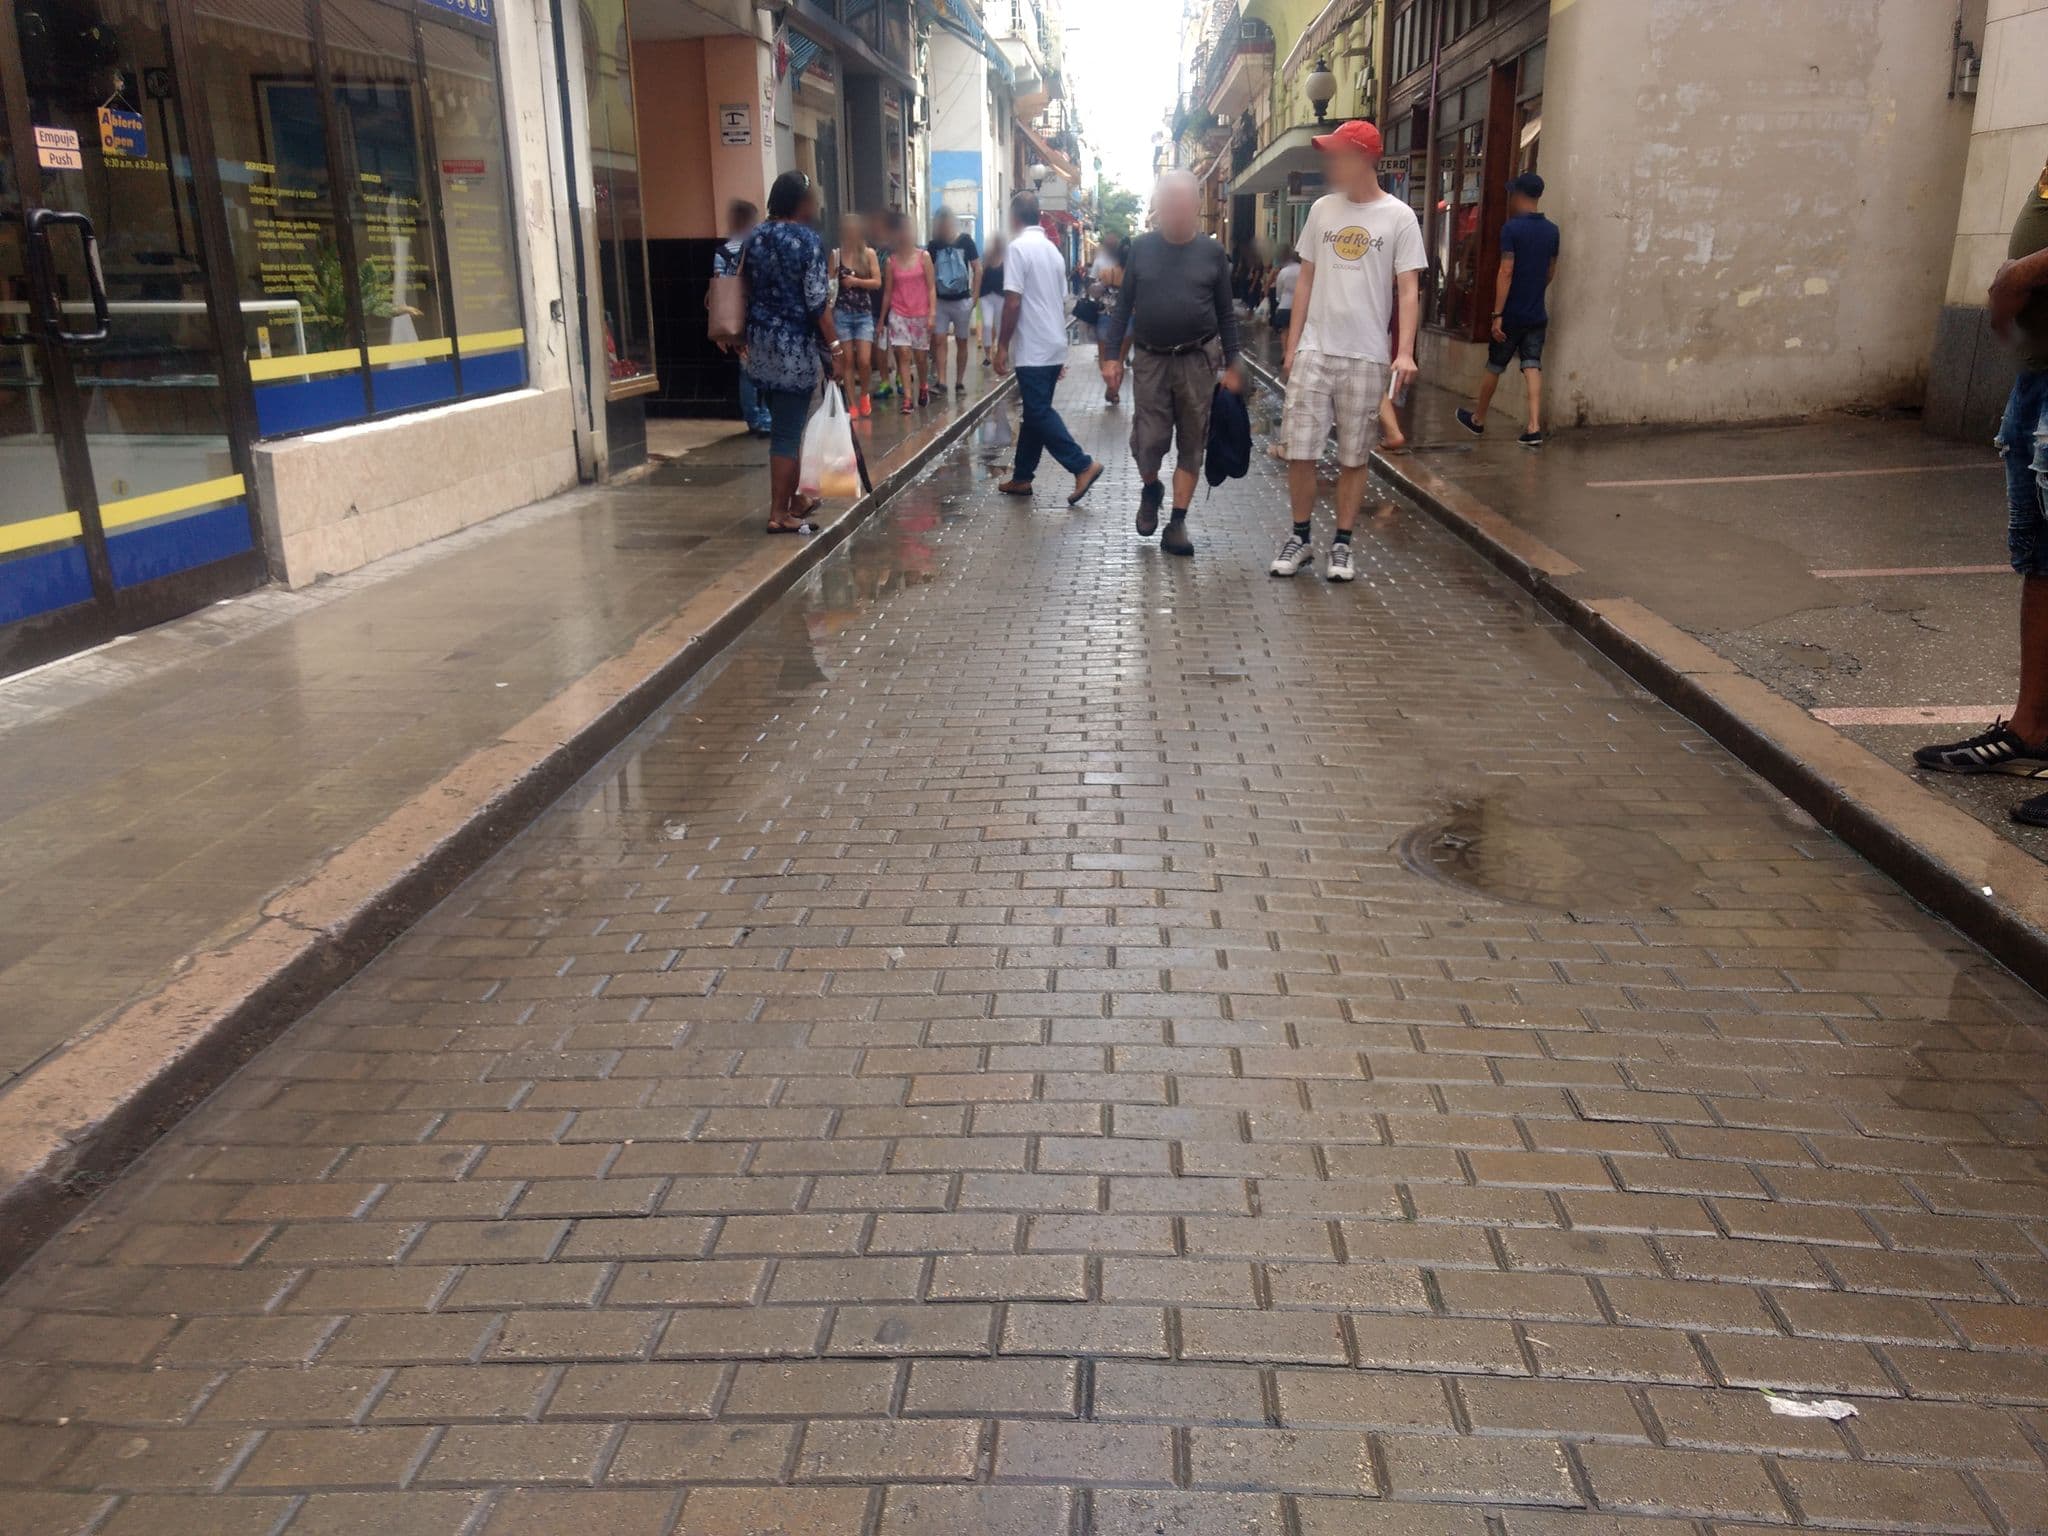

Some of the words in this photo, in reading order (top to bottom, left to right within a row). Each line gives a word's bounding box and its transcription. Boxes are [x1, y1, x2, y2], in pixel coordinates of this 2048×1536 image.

[102, 112, 142, 130] Abierto
[39, 130, 75, 146] Empuje
[104, 135, 133, 148] Open
[49, 153, 73, 166] Push
[1322, 230, 1354, 244] Hard
[1353, 233, 1384, 252] Rock
